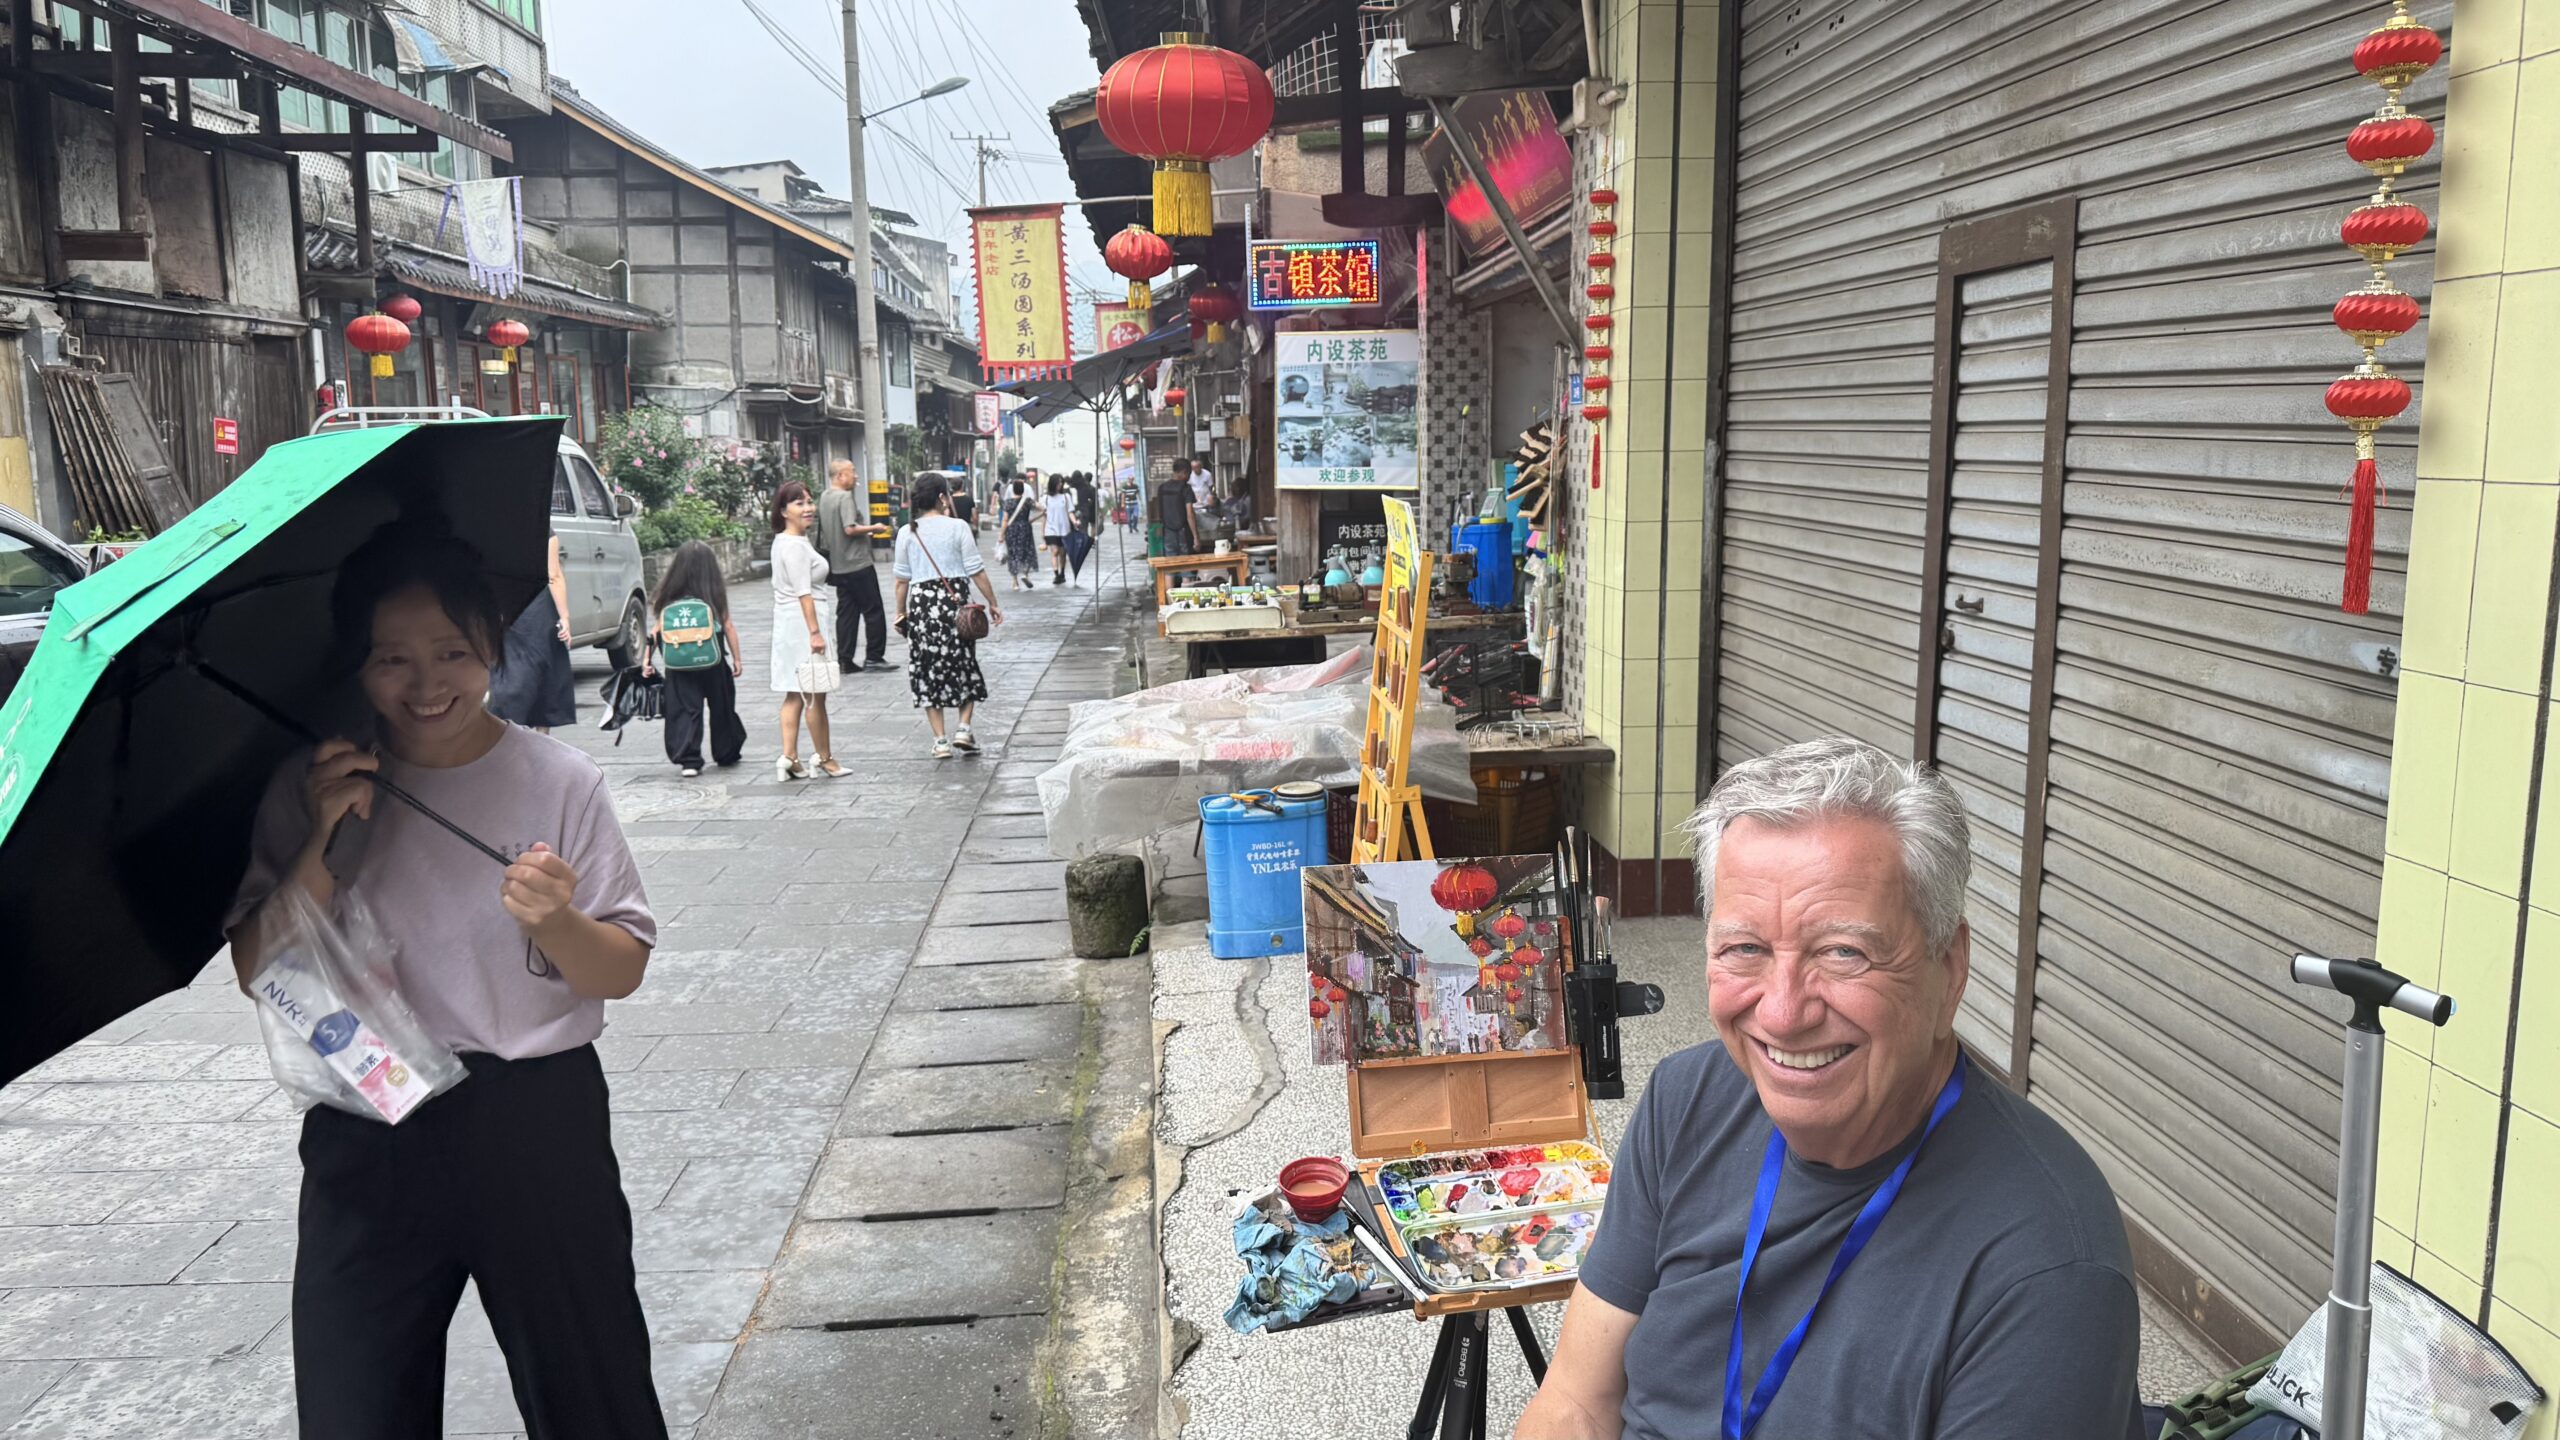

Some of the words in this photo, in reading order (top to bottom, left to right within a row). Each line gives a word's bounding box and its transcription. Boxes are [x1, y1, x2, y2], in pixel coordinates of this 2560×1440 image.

[1259, 247, 1373, 299] 古镇茶馆
[1307, 338, 1388, 362] 内设茶苑
[1319, 468, 1376, 483] 欢迎参观
[1338, 524, 1386, 539] 内设茶苑
[1458, 1347, 1468, 1377] BENRO
